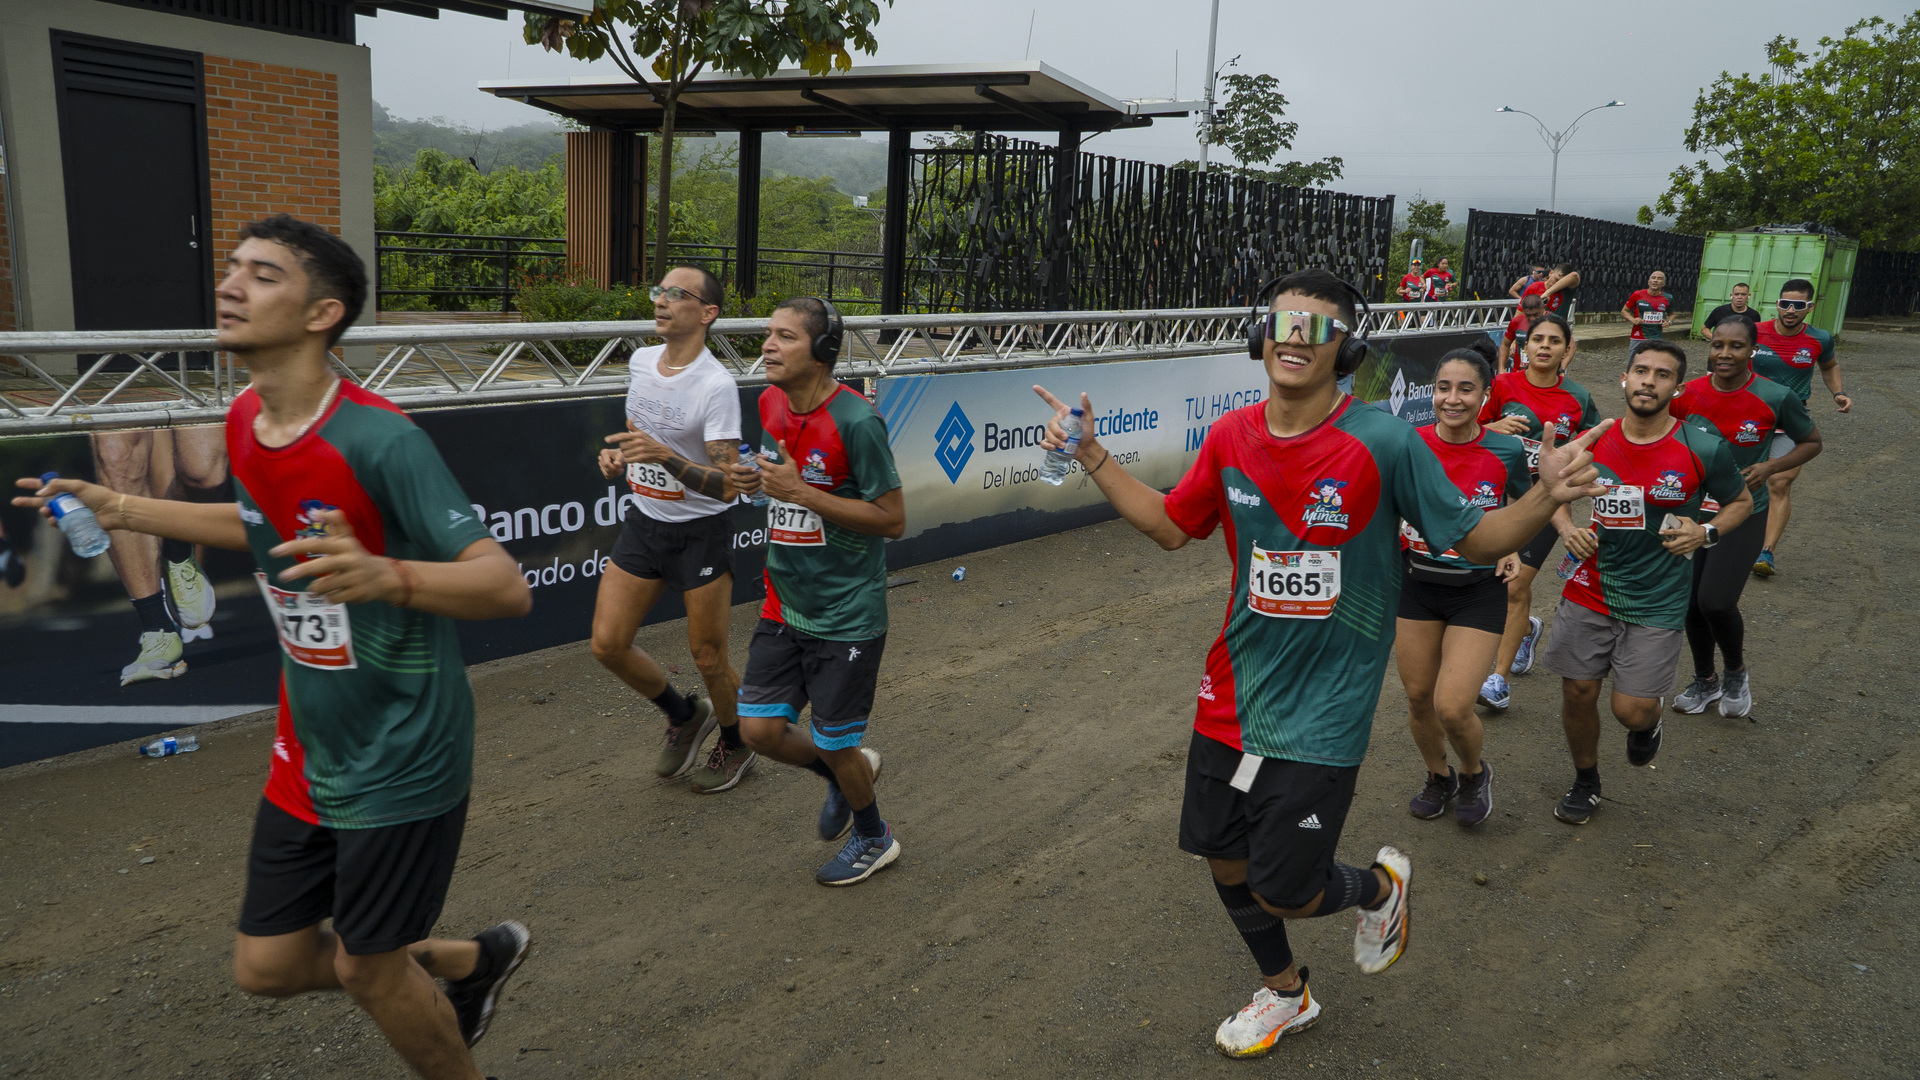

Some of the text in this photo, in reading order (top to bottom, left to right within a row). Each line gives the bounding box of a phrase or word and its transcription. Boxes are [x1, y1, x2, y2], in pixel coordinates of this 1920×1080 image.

[1407, 382, 1434, 401] Banco
[1185, 396, 1206, 421] TU
[984, 406, 1159, 453] Banco ccidente
[1184, 425, 1213, 453] IM
[638, 466, 667, 487] 335
[983, 467, 1007, 490] Del
[1009, 462, 1039, 486] lado
[594, 485, 634, 527] de
[769, 505, 809, 529] 1877
[1301, 509, 1350, 525] Muñeca
[581, 549, 611, 578] de
[1255, 569, 1322, 597] 1665
